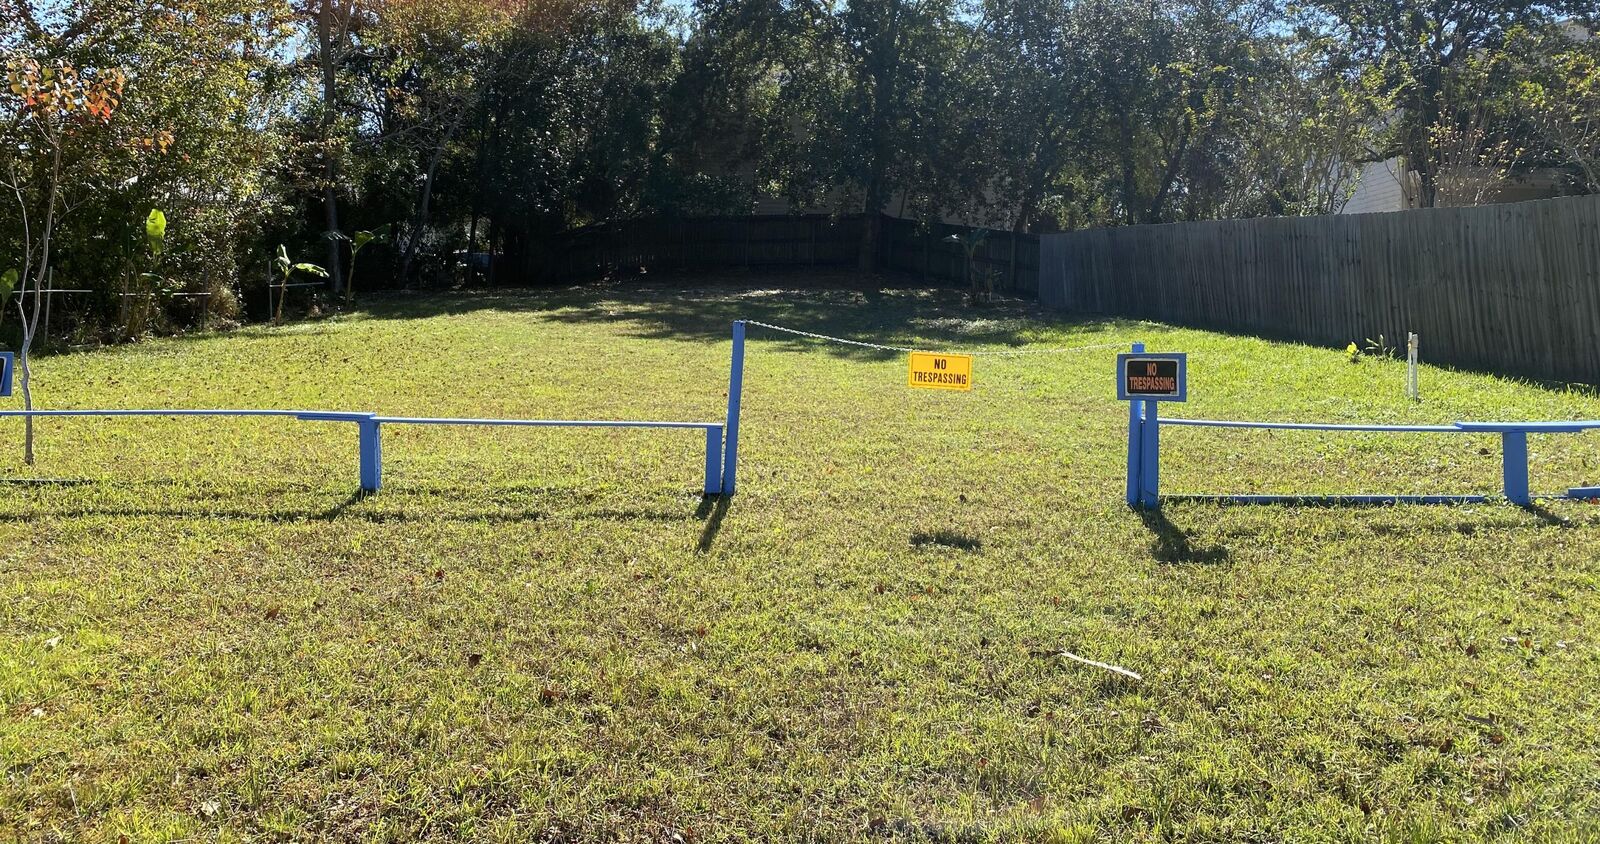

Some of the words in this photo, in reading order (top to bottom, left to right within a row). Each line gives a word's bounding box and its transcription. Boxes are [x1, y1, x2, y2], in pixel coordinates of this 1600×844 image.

[934, 358, 947, 370] NO
[1146, 362, 1157, 376] NO
[913, 371, 967, 385] TRESPASSING
[1129, 376, 1175, 390] TRESPASSING
